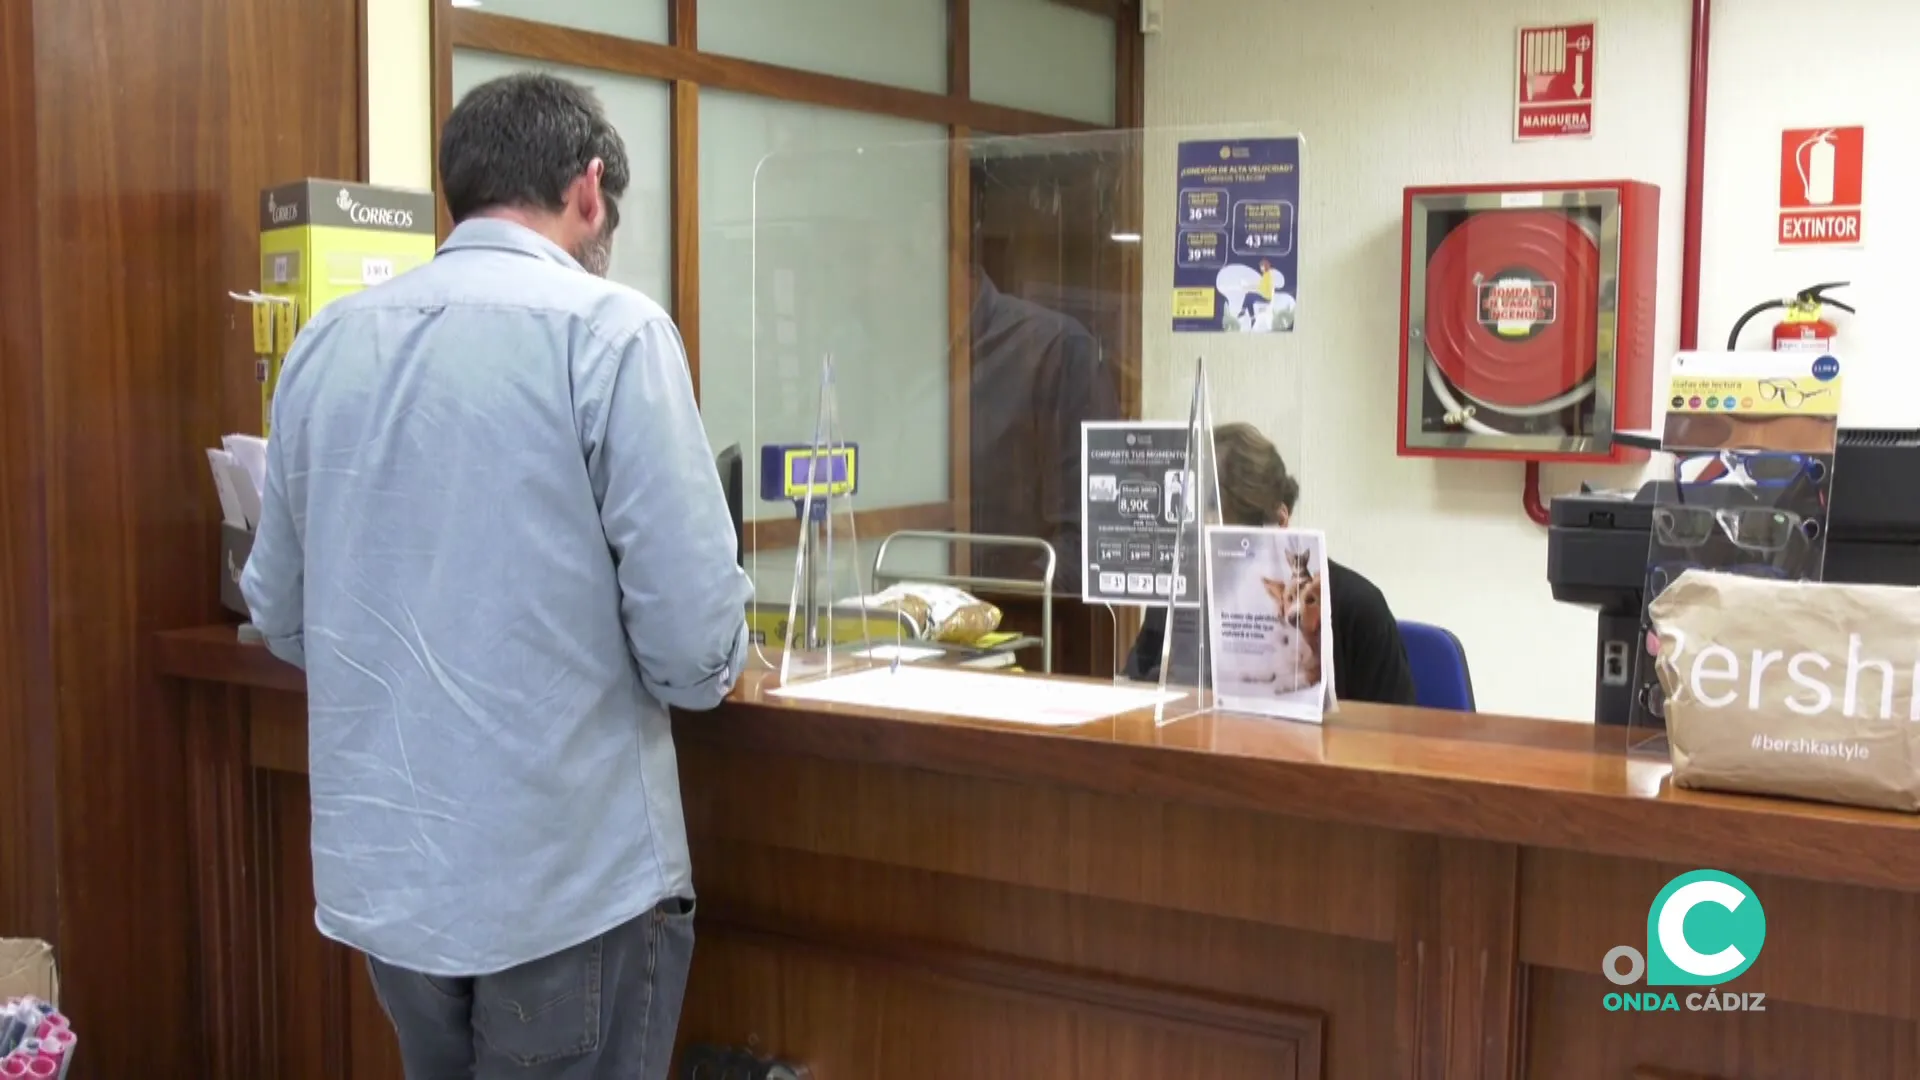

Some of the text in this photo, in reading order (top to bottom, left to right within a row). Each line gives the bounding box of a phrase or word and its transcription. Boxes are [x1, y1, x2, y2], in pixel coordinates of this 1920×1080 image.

[1523, 112, 1587, 128] MANGUERA
[1229, 165, 1248, 174] ALTA
[1783, 216, 1857, 239] EXTINTOR
[1672, 379, 1742, 389] Gafas de lectura
[1131, 449, 1146, 459] TUS
[1751, 734, 1870, 762] #bershkastyle
